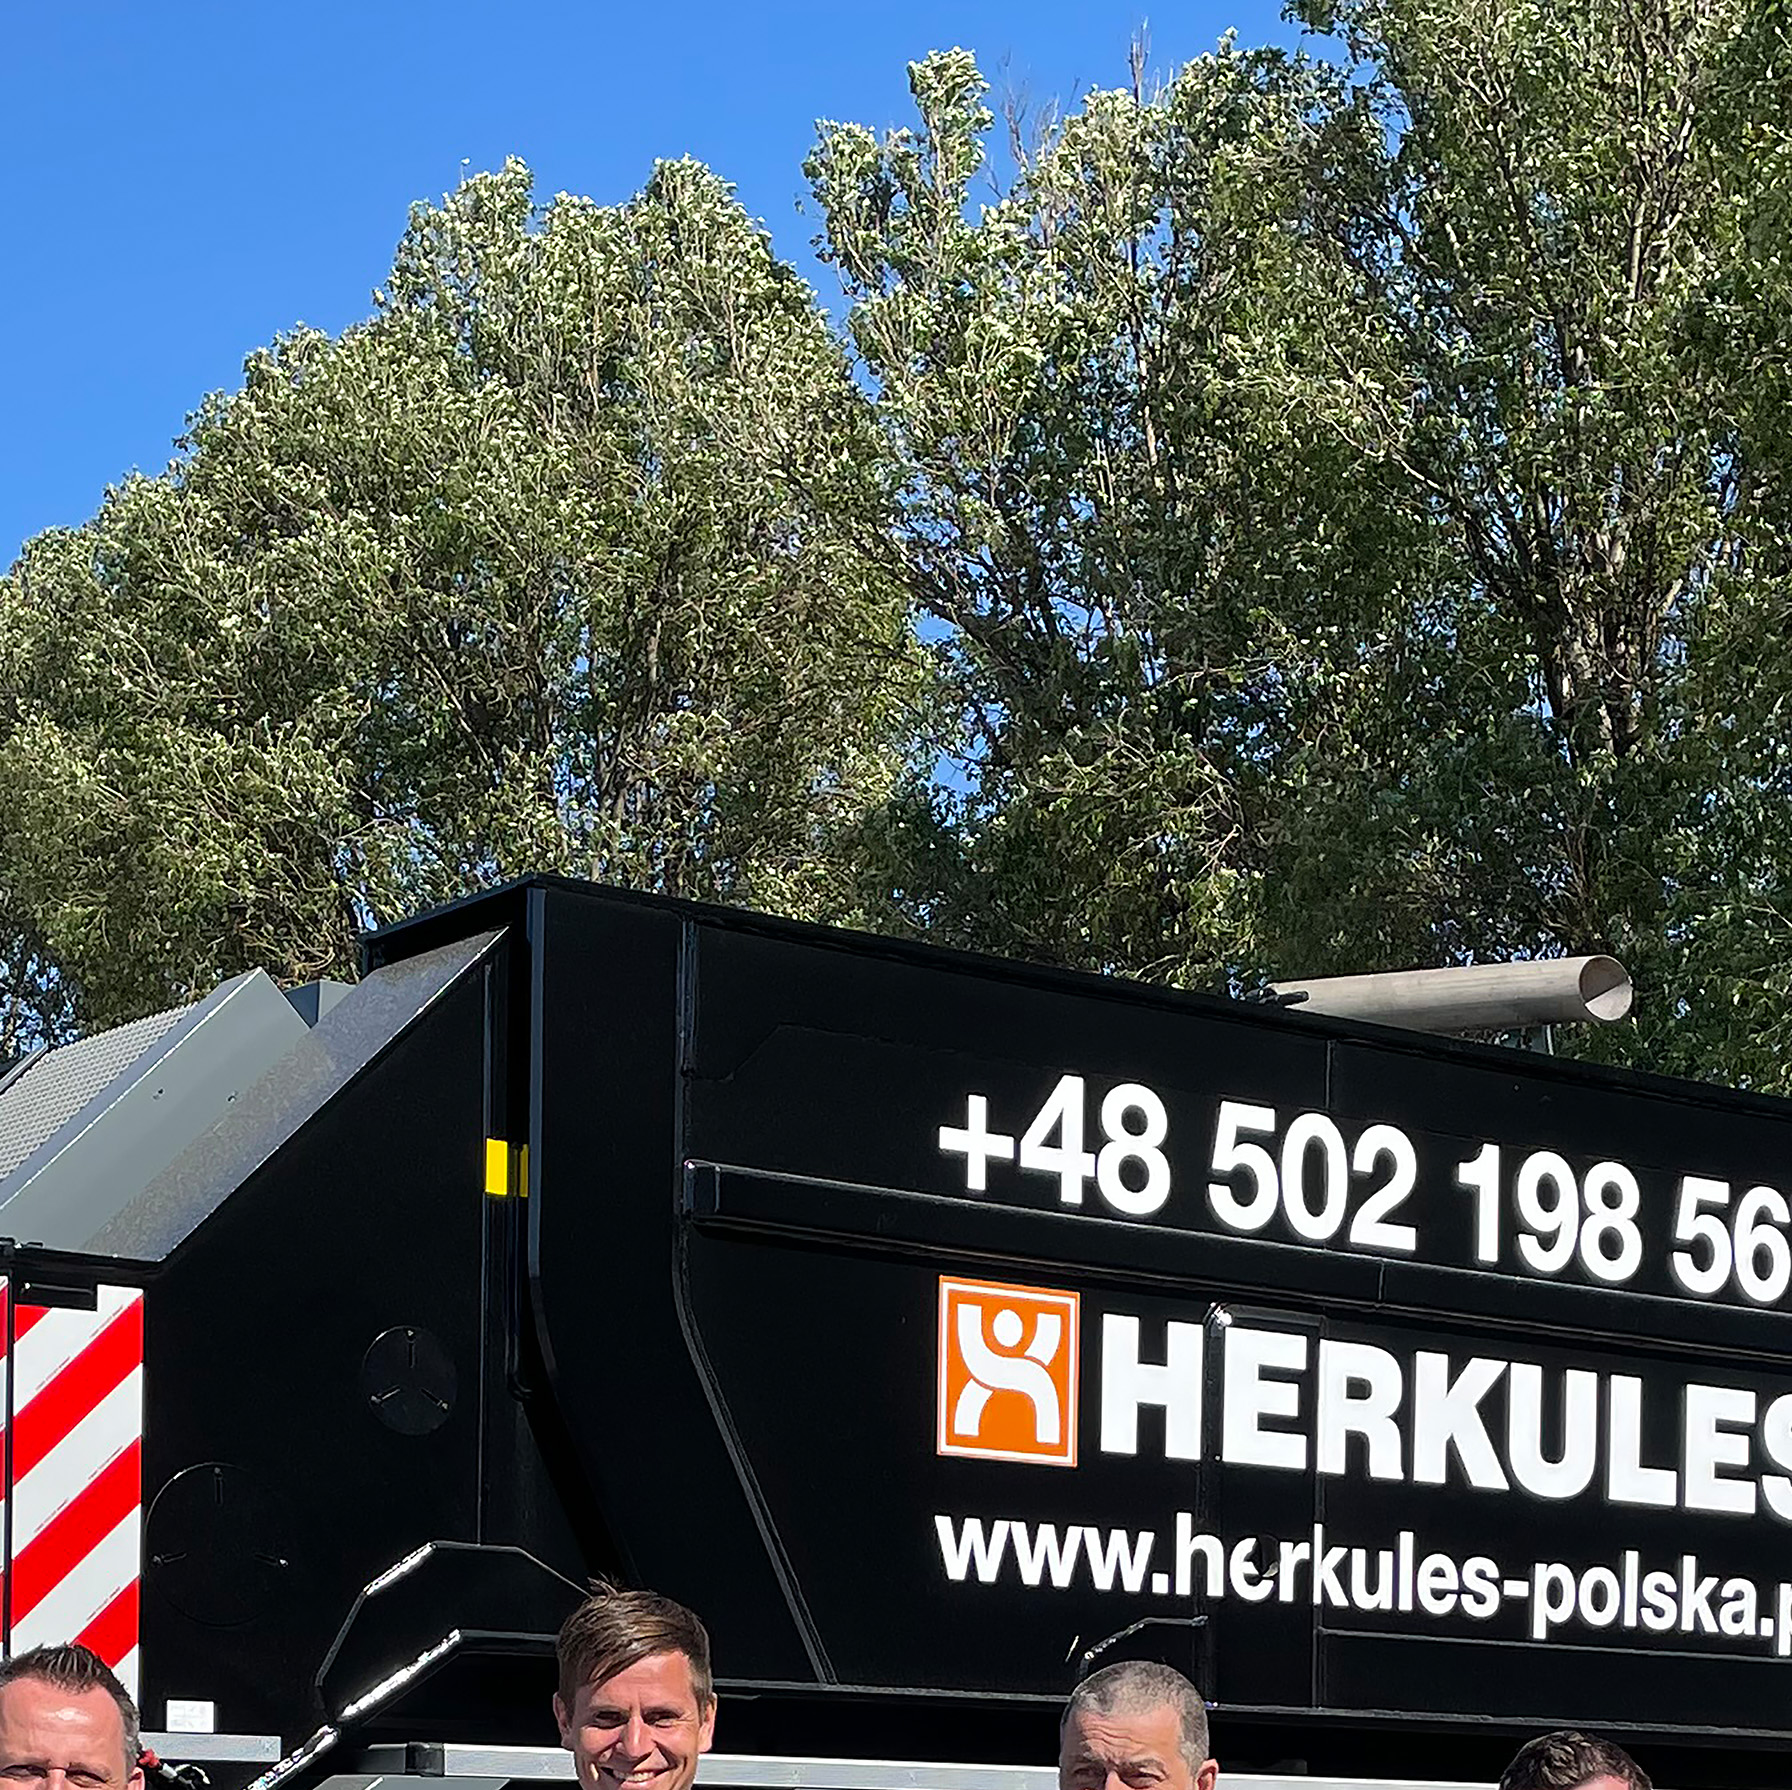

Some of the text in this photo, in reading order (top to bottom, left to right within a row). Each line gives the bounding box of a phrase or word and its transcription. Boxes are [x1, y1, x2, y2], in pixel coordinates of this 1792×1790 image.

[938, 1074, 1171, 1216] +48
[1208, 1100, 1418, 1252] 502
[1457, 1143, 1644, 1283] 198
